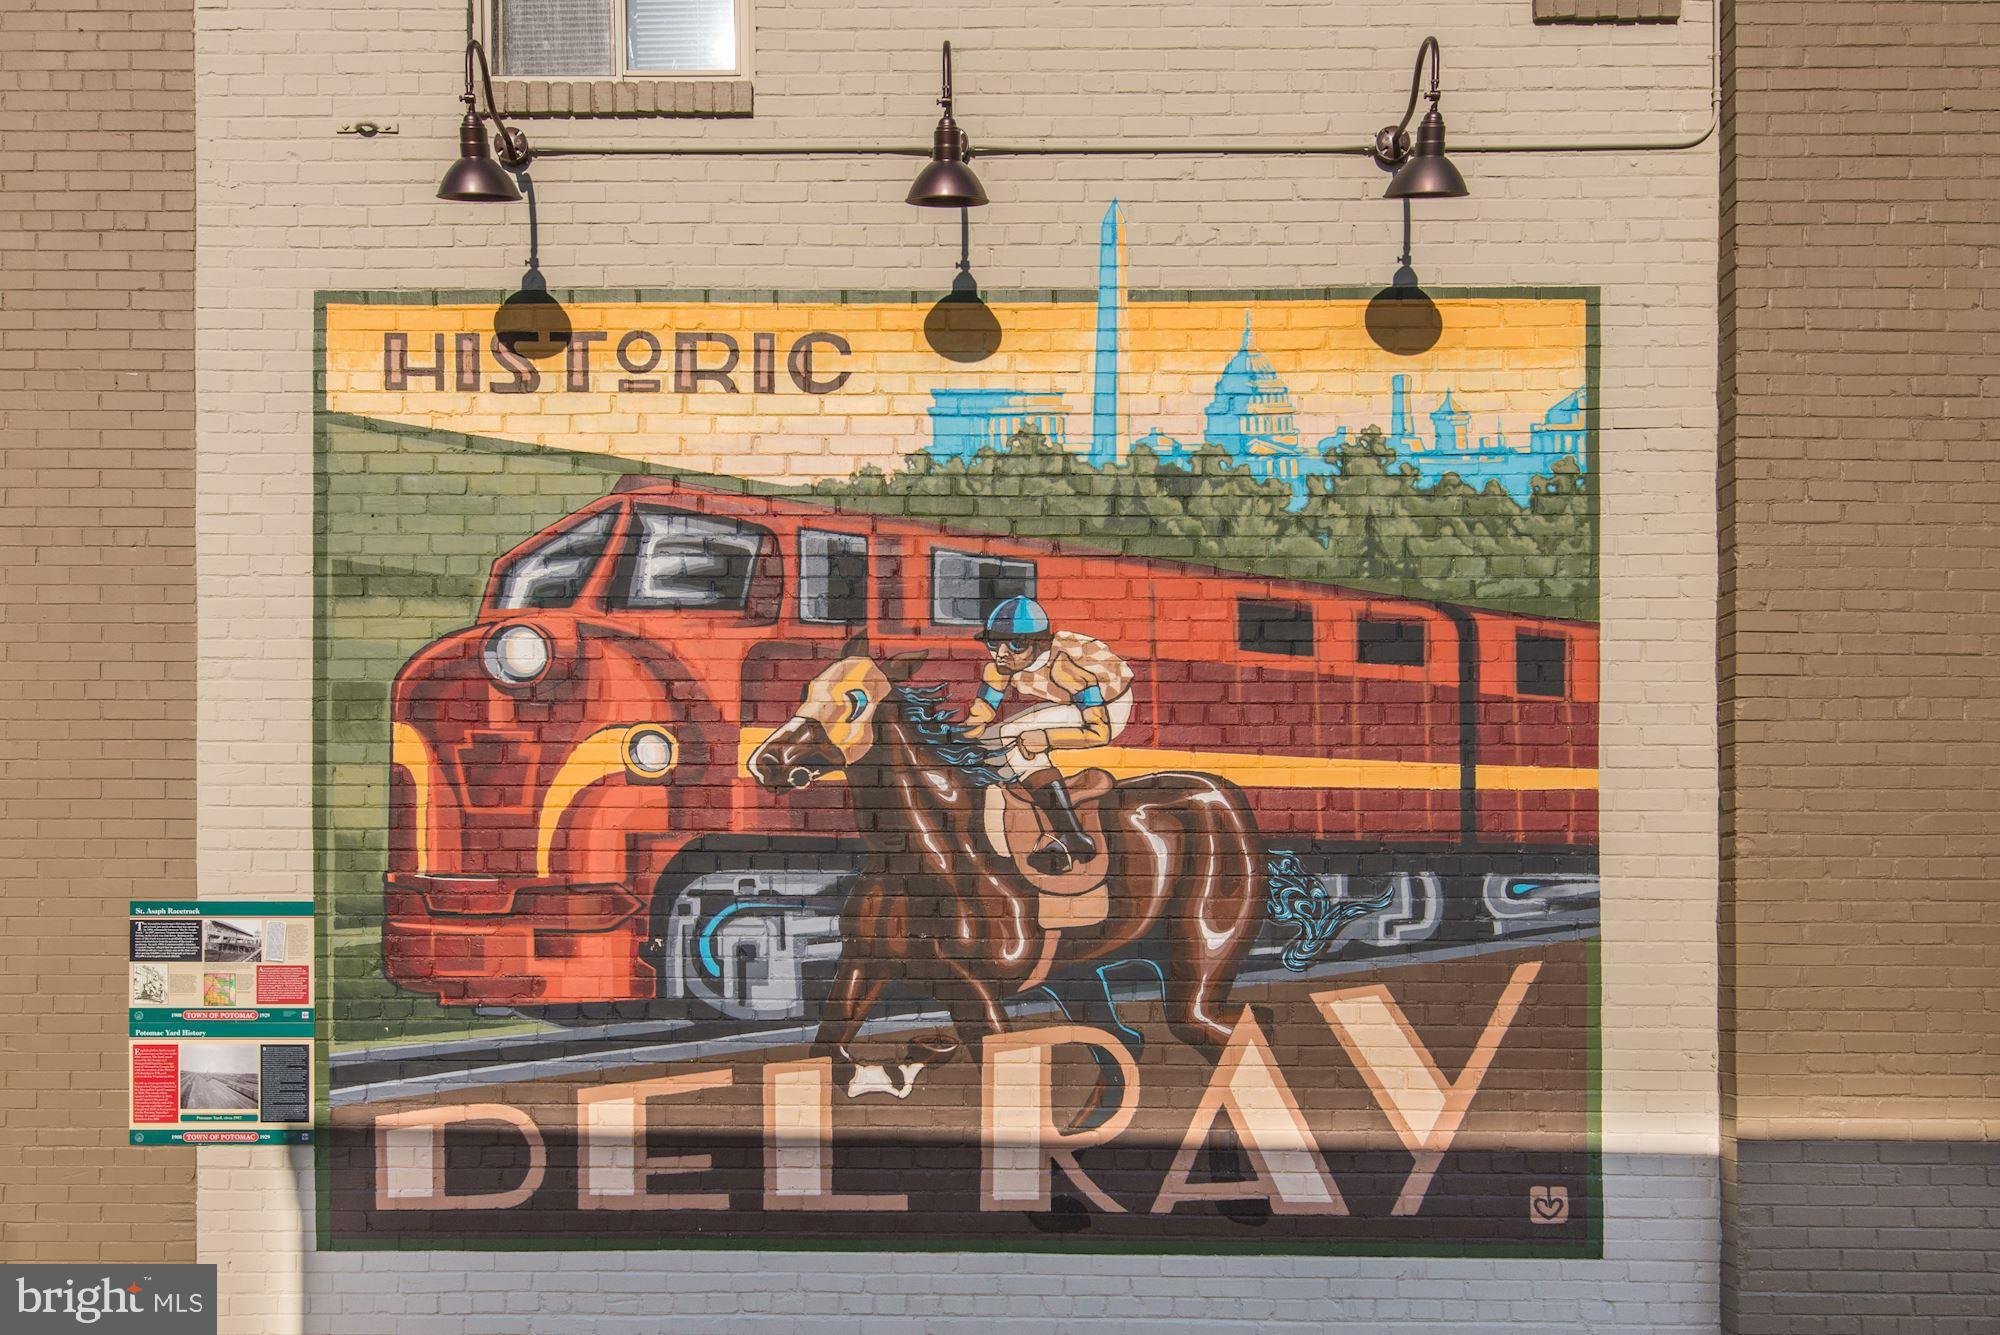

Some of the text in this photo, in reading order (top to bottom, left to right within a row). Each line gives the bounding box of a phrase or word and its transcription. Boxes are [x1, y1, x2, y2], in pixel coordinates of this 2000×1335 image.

[146, 907, 166, 916] Asaph
[167, 907, 200, 915] Racetrack
[186, 1011, 208, 1019] TOWN
[209, 1011, 219, 1019] OF
[220, 1011, 256, 1019] POTOMAC
[135, 1029, 207, 1038] Potomac Yard History
[376, 960, 1543, 1215] DEL RAY
